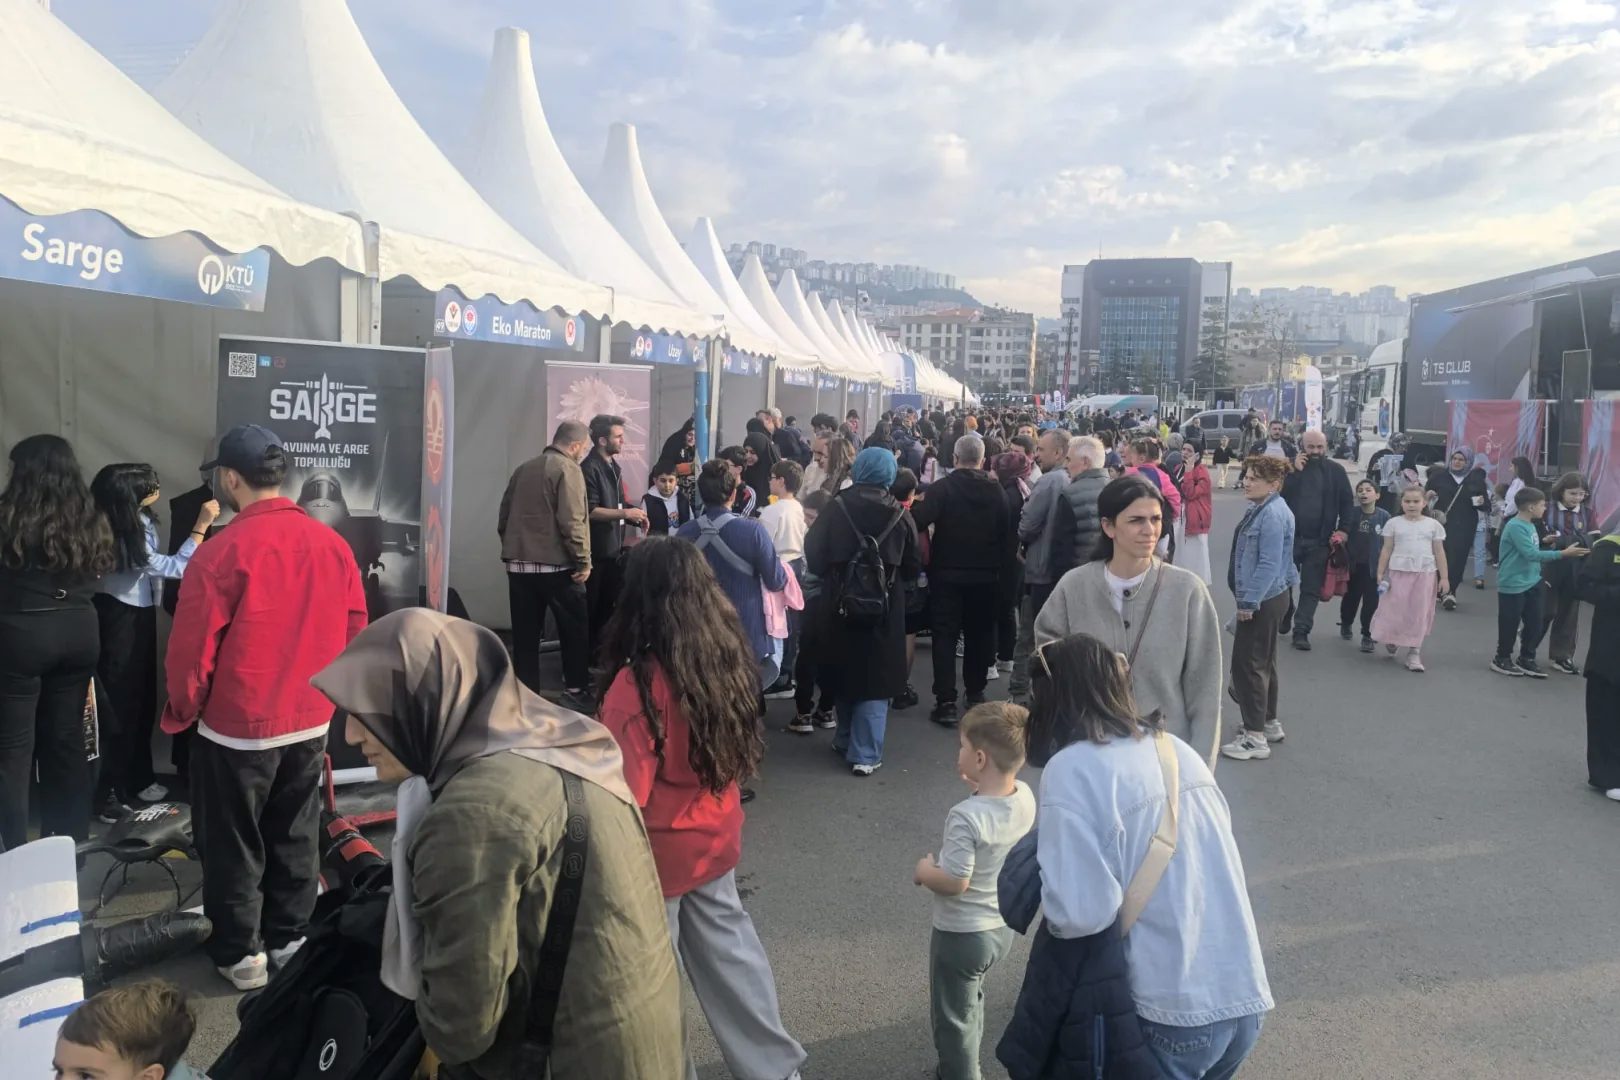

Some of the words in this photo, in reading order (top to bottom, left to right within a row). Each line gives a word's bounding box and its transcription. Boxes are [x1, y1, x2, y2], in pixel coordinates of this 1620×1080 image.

[21, 223, 124, 280] Sarge
[225, 264, 254, 286] KTÜ
[492, 315, 512, 336] Eko
[514, 319, 551, 341] Maraton
[1432, 362, 1445, 375] TS
[1446, 360, 1471, 374] CLUB
[270, 386, 377, 425] SARGE
[282, 441, 327, 454] AVUNMA
[328, 443, 341, 454] VE
[343, 443, 370, 455] ARGE
[293, 455, 351, 468] TOPLULUĞU
